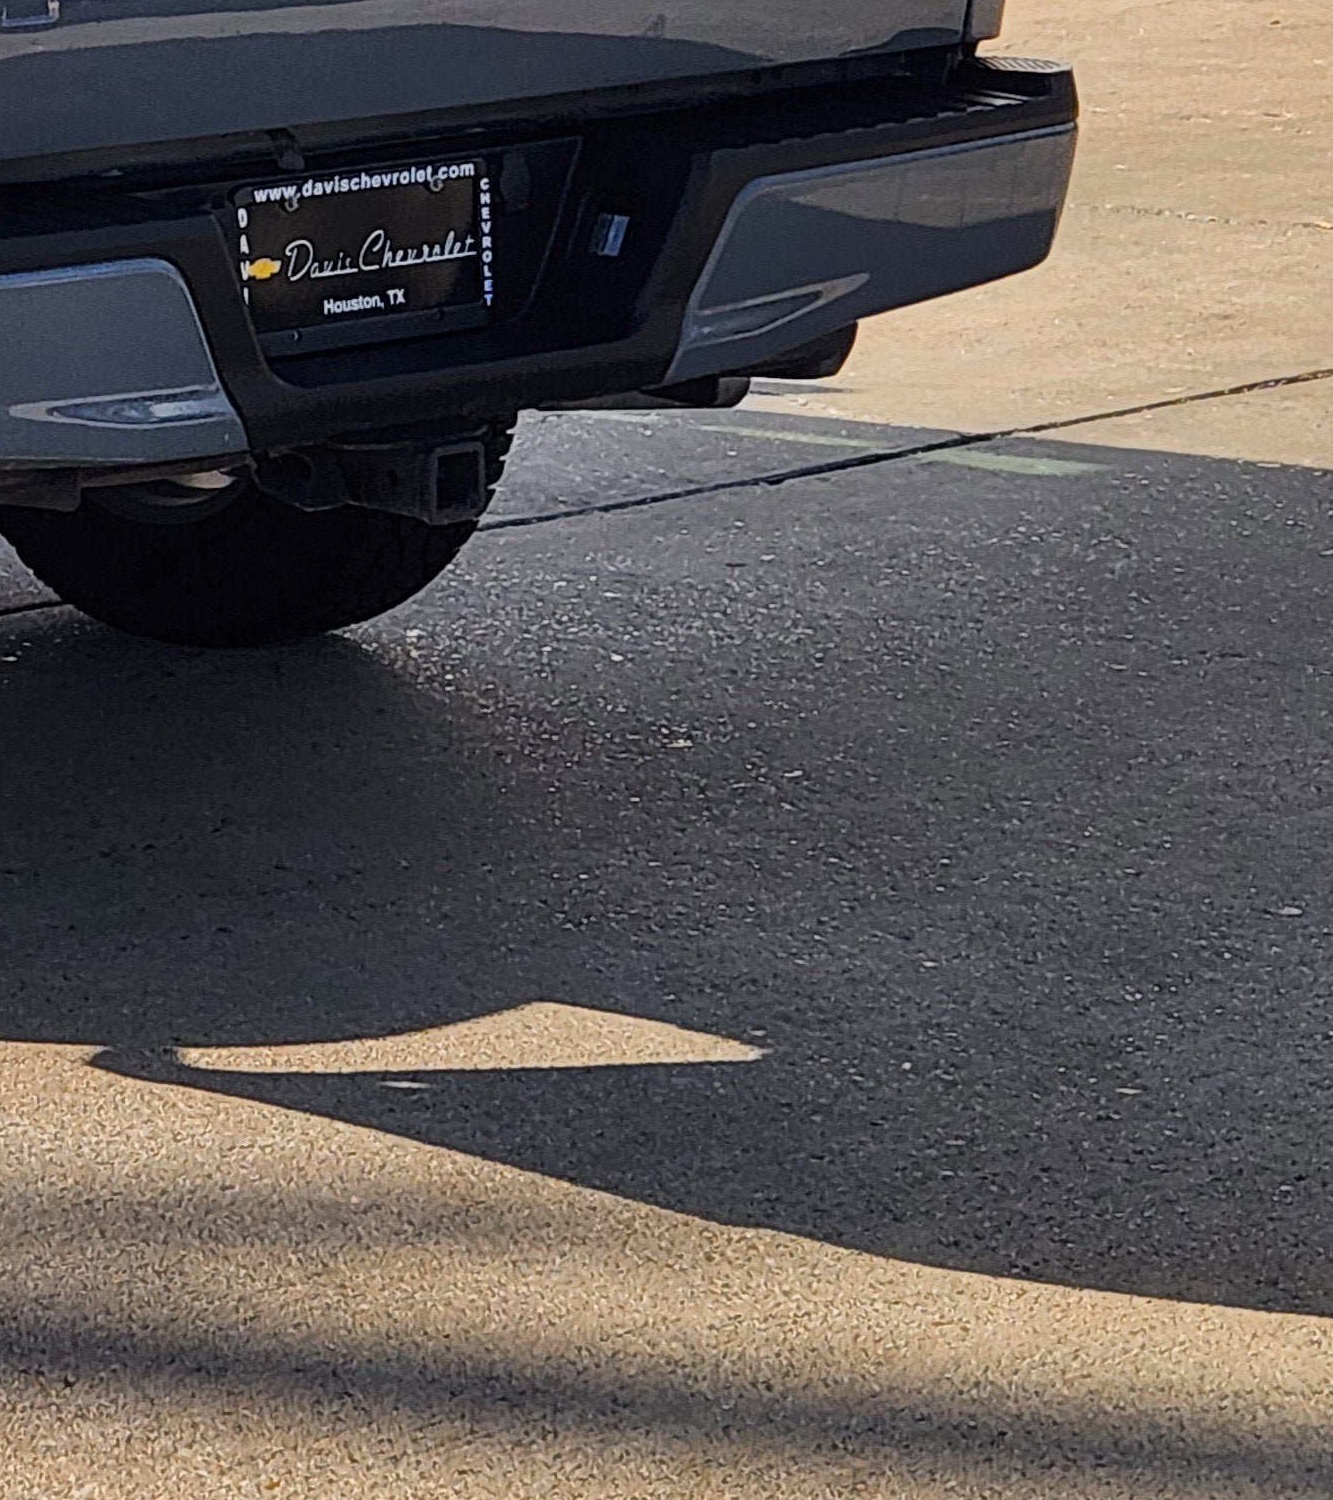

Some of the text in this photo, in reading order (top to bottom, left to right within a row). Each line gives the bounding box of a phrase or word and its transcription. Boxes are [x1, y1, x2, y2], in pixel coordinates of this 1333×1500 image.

[253, 161, 476, 204] www.davischevrolet.com
[237, 207, 252, 306] DAVI
[285, 229, 478, 283] Davis Chevrolet
[479, 176, 494, 307] CHEVROLET
[323, 288, 406, 315] Houston, TX
